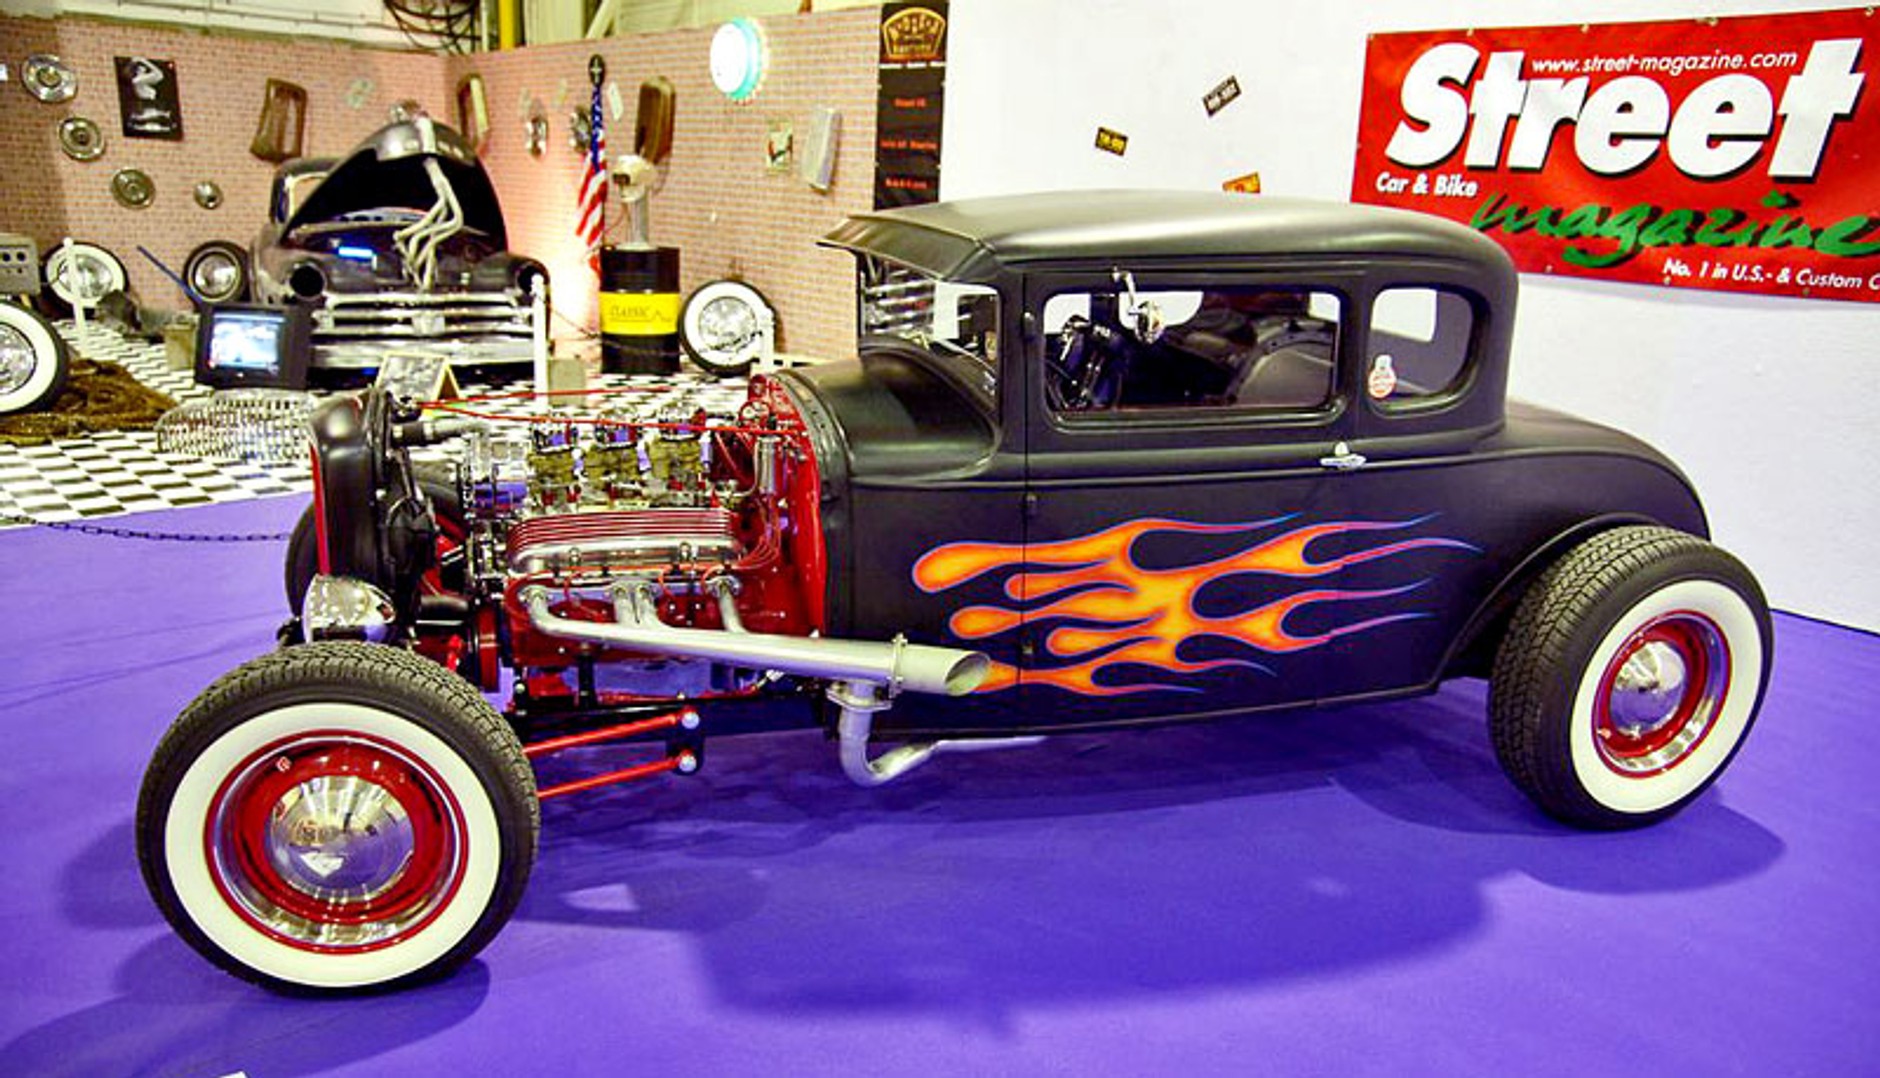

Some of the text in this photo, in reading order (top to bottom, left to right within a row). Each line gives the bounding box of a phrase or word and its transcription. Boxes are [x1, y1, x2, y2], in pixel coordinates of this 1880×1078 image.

[1531, 49, 1799, 76] www.street-magazine.com
[1384, 37, 1866, 180] Street
[1375, 171, 1479, 198] Car & Bike
[1470, 190, 1880, 266] magazine
[1662, 257, 1692, 276] No.
[1699, 261, 1710, 278] 1
[1711, 262, 1729, 280] in
[1775, 267, 1792, 284] &
[1795, 268, 1863, 289] Custom
